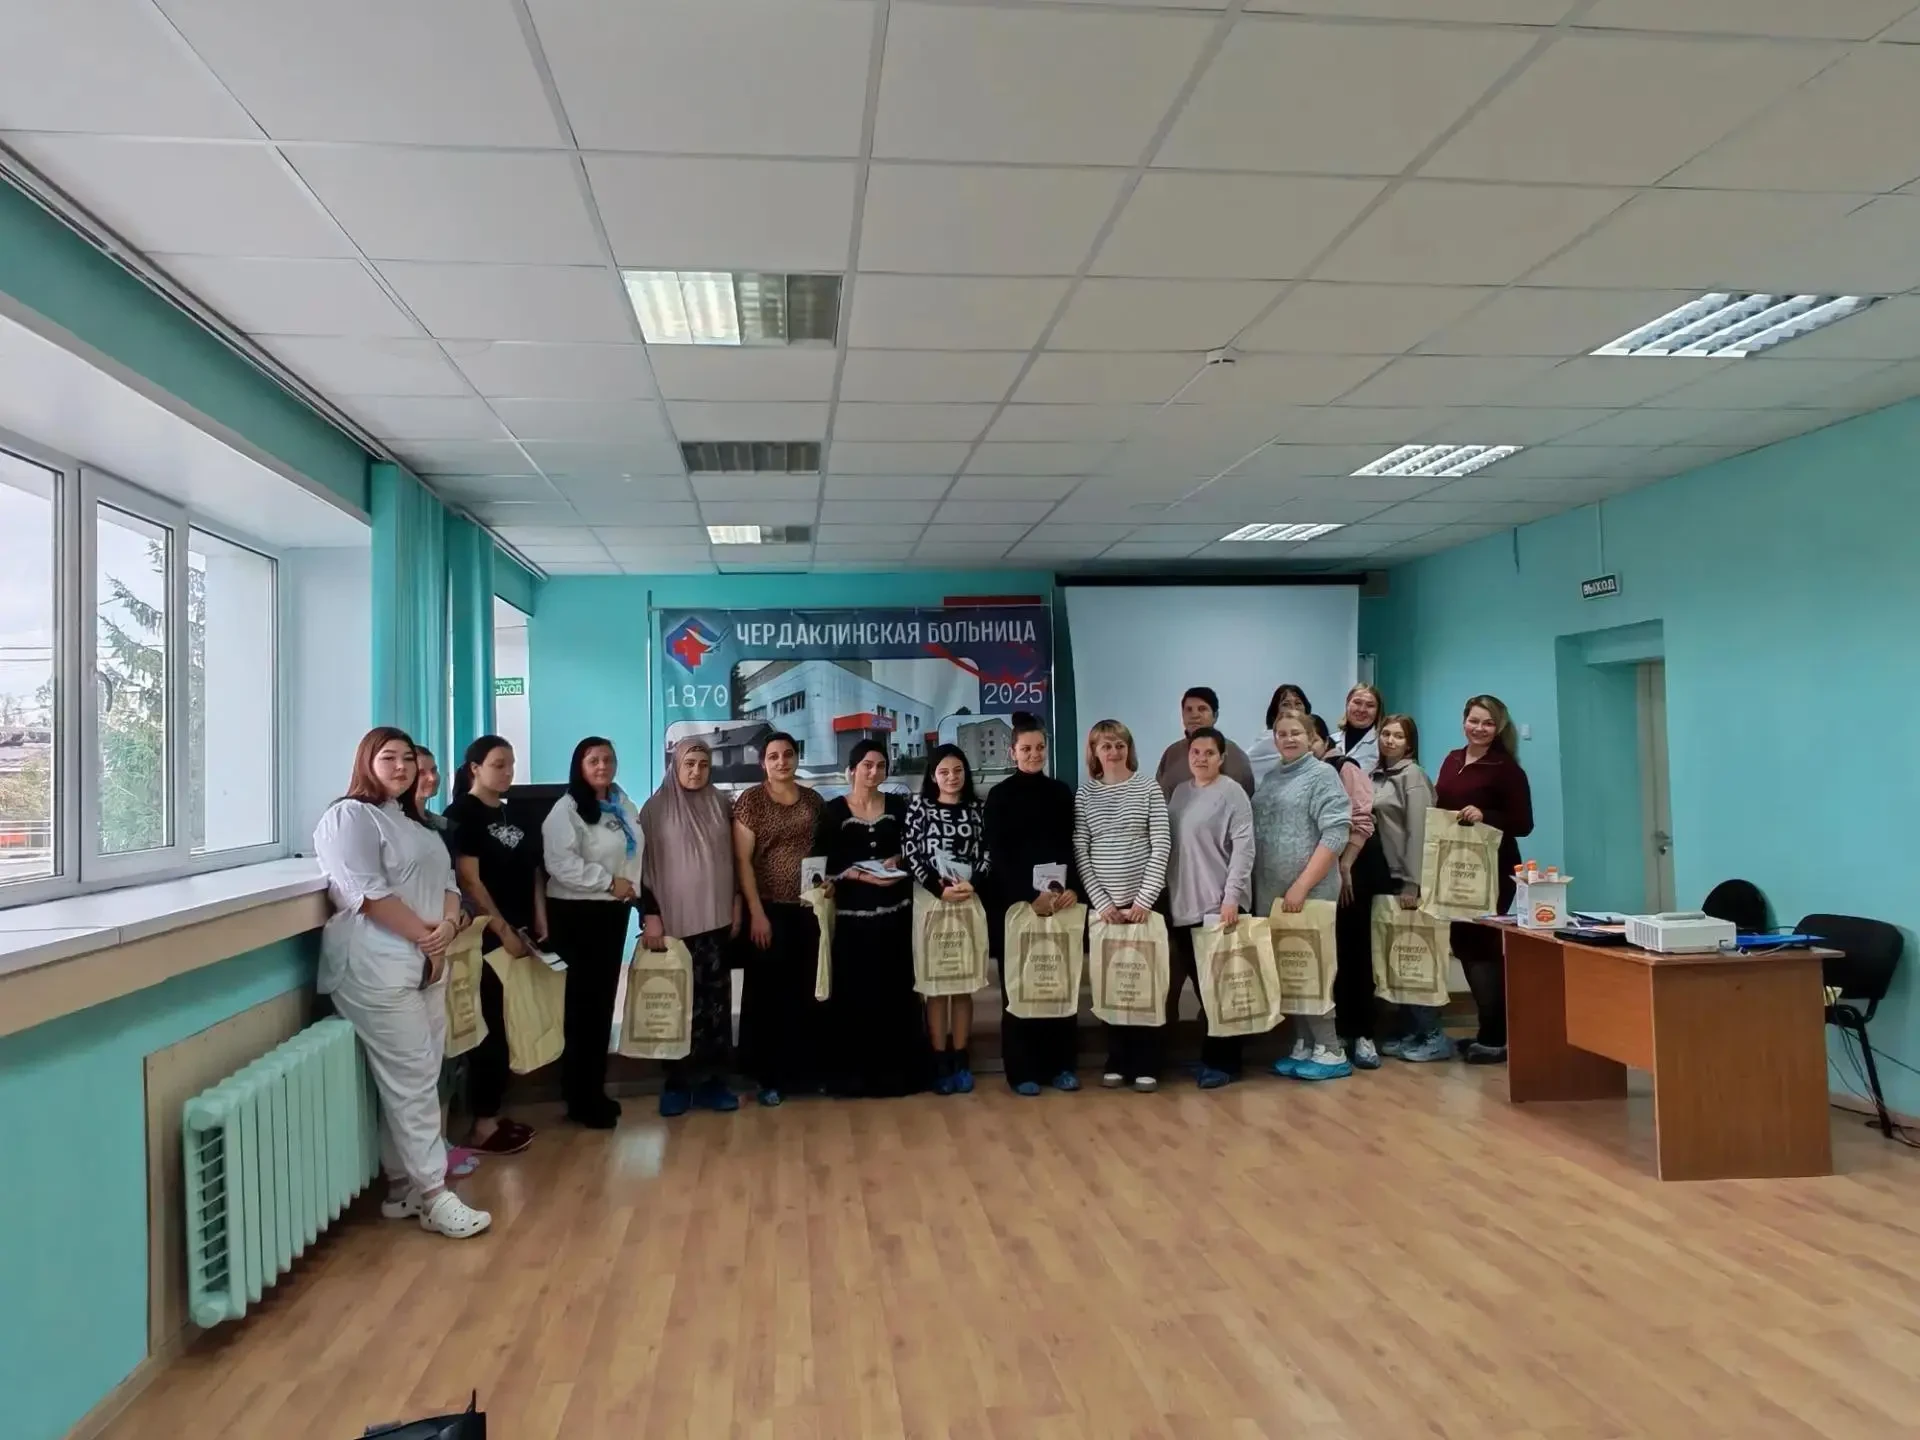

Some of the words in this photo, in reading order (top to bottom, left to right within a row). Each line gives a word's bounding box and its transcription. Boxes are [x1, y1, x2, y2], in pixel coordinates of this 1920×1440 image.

[1583, 578, 1615, 595] ВЫХОД
[736, 622, 921, 649] ЧЕРДАКЛИНСКАЯ
[928, 619, 1037, 645] БОЛЬНИЦА
[495, 685, 522, 695] ЫХОД
[667, 684, 729, 709] 1870
[984, 681, 1043, 705] 2025
